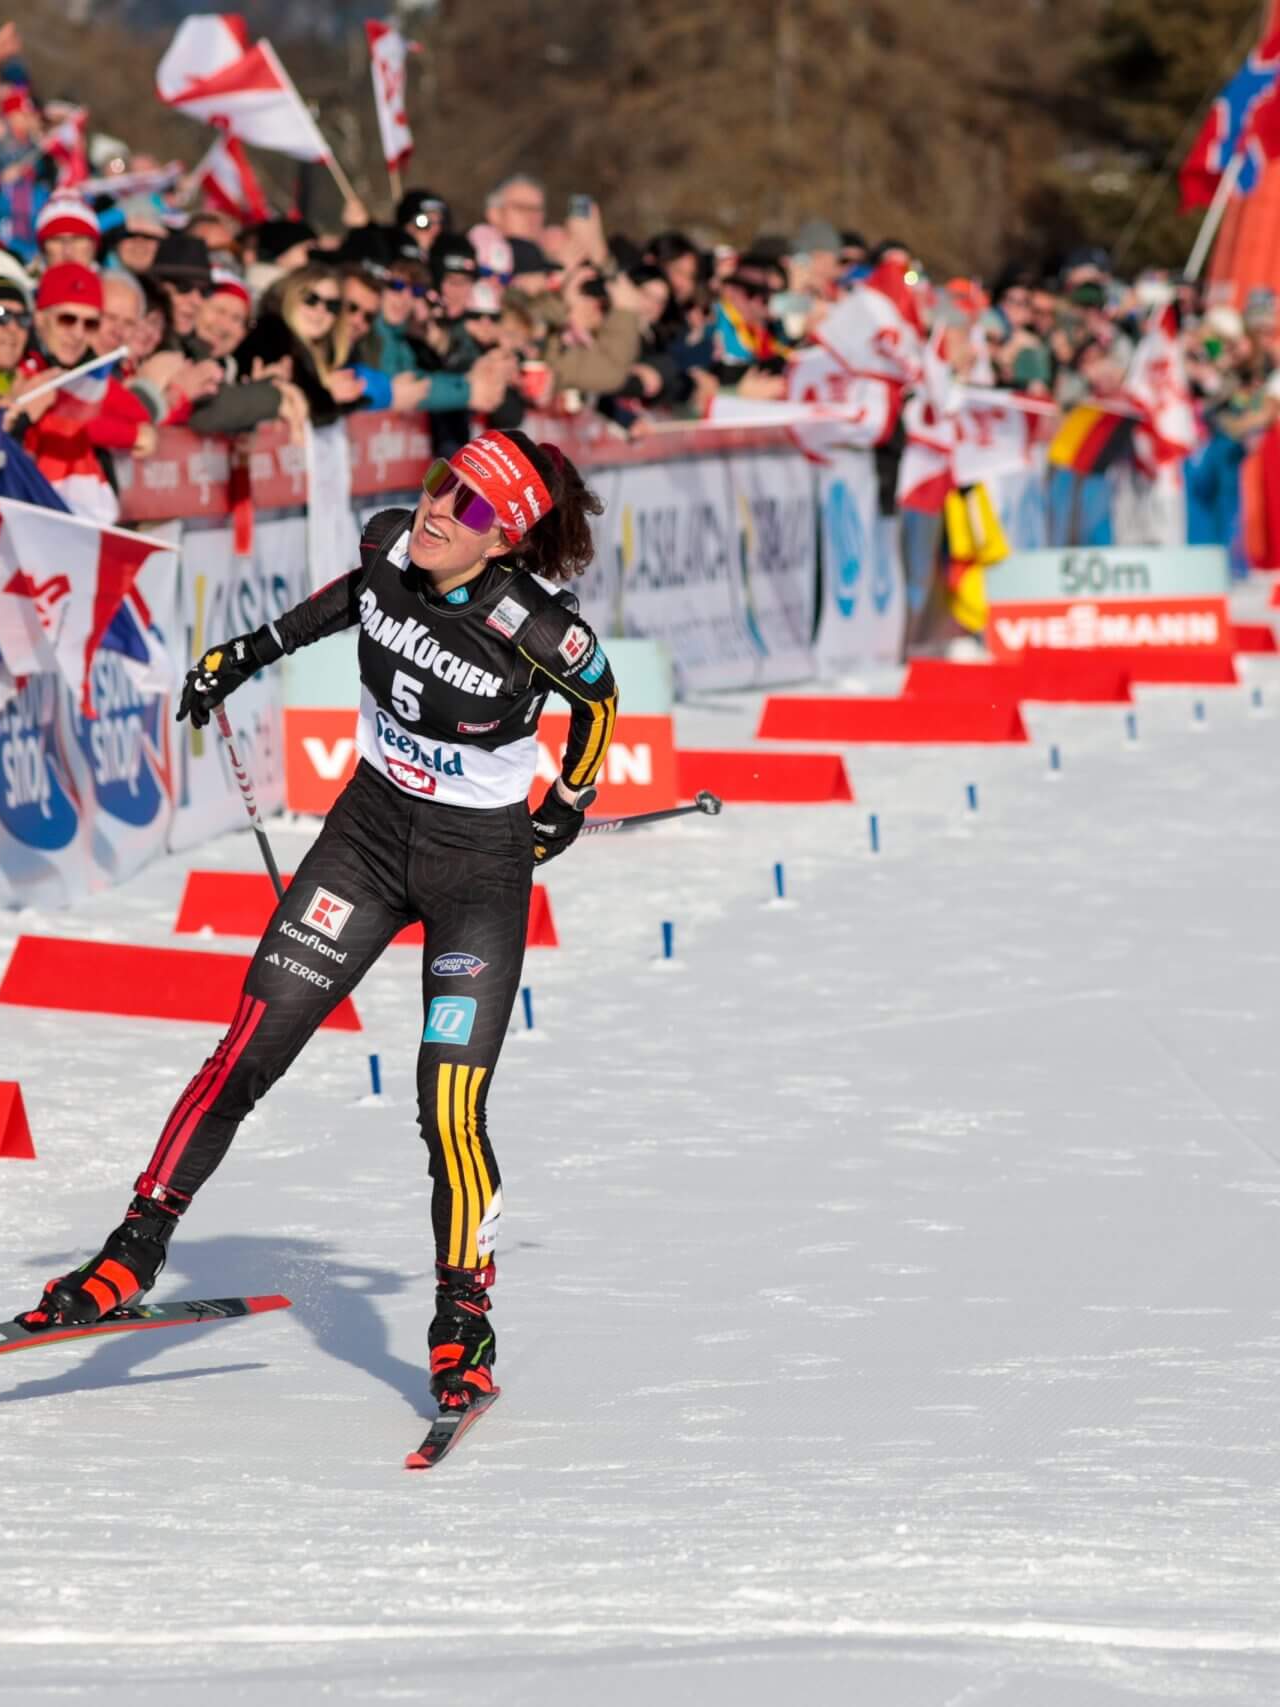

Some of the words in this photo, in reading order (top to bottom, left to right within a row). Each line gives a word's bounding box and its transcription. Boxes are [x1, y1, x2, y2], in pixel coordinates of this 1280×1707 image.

[1060, 553, 1151, 594] 50m
[995, 604, 1219, 651] VIESSMANN
[391, 669, 424, 722] 5
[375, 710, 465, 777] Seefeld
[278, 919, 348, 966] Kaufland
[433, 956, 477, 969] personal
[282, 956, 335, 992] TERREX
[439, 962, 463, 972] shop
[429, 1002, 466, 1039] TQ
